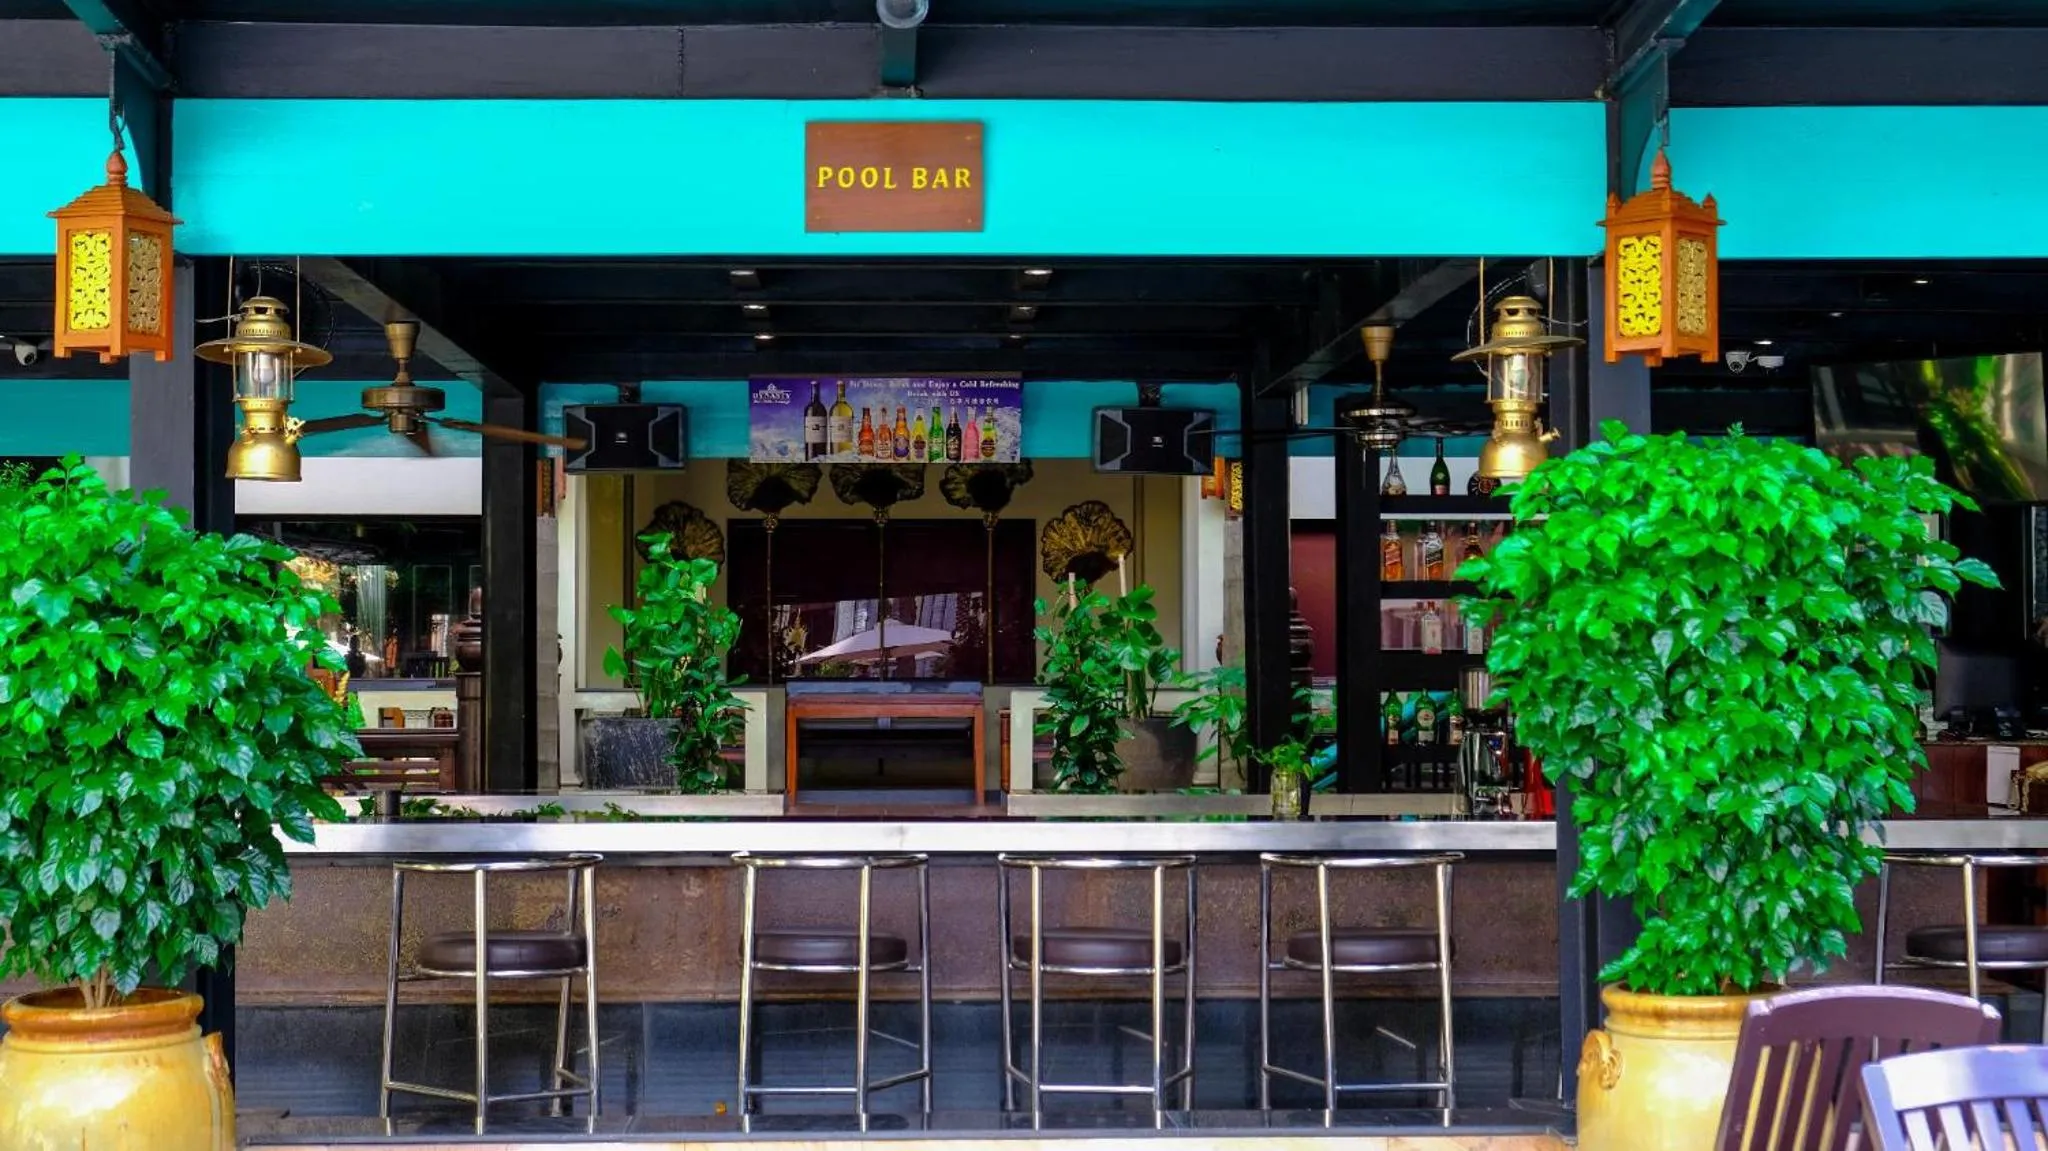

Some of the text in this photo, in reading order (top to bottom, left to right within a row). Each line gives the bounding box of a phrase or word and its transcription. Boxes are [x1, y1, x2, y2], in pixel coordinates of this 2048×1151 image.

[816, 166, 972, 190] POOL BAR
[928, 380, 951, 391] Enjoy
[959, 379, 977, 388] Cold
[980, 379, 1020, 390] Refreshing
[752, 392, 792, 400] DYNASTY
[907, 390, 929, 398] Drink
